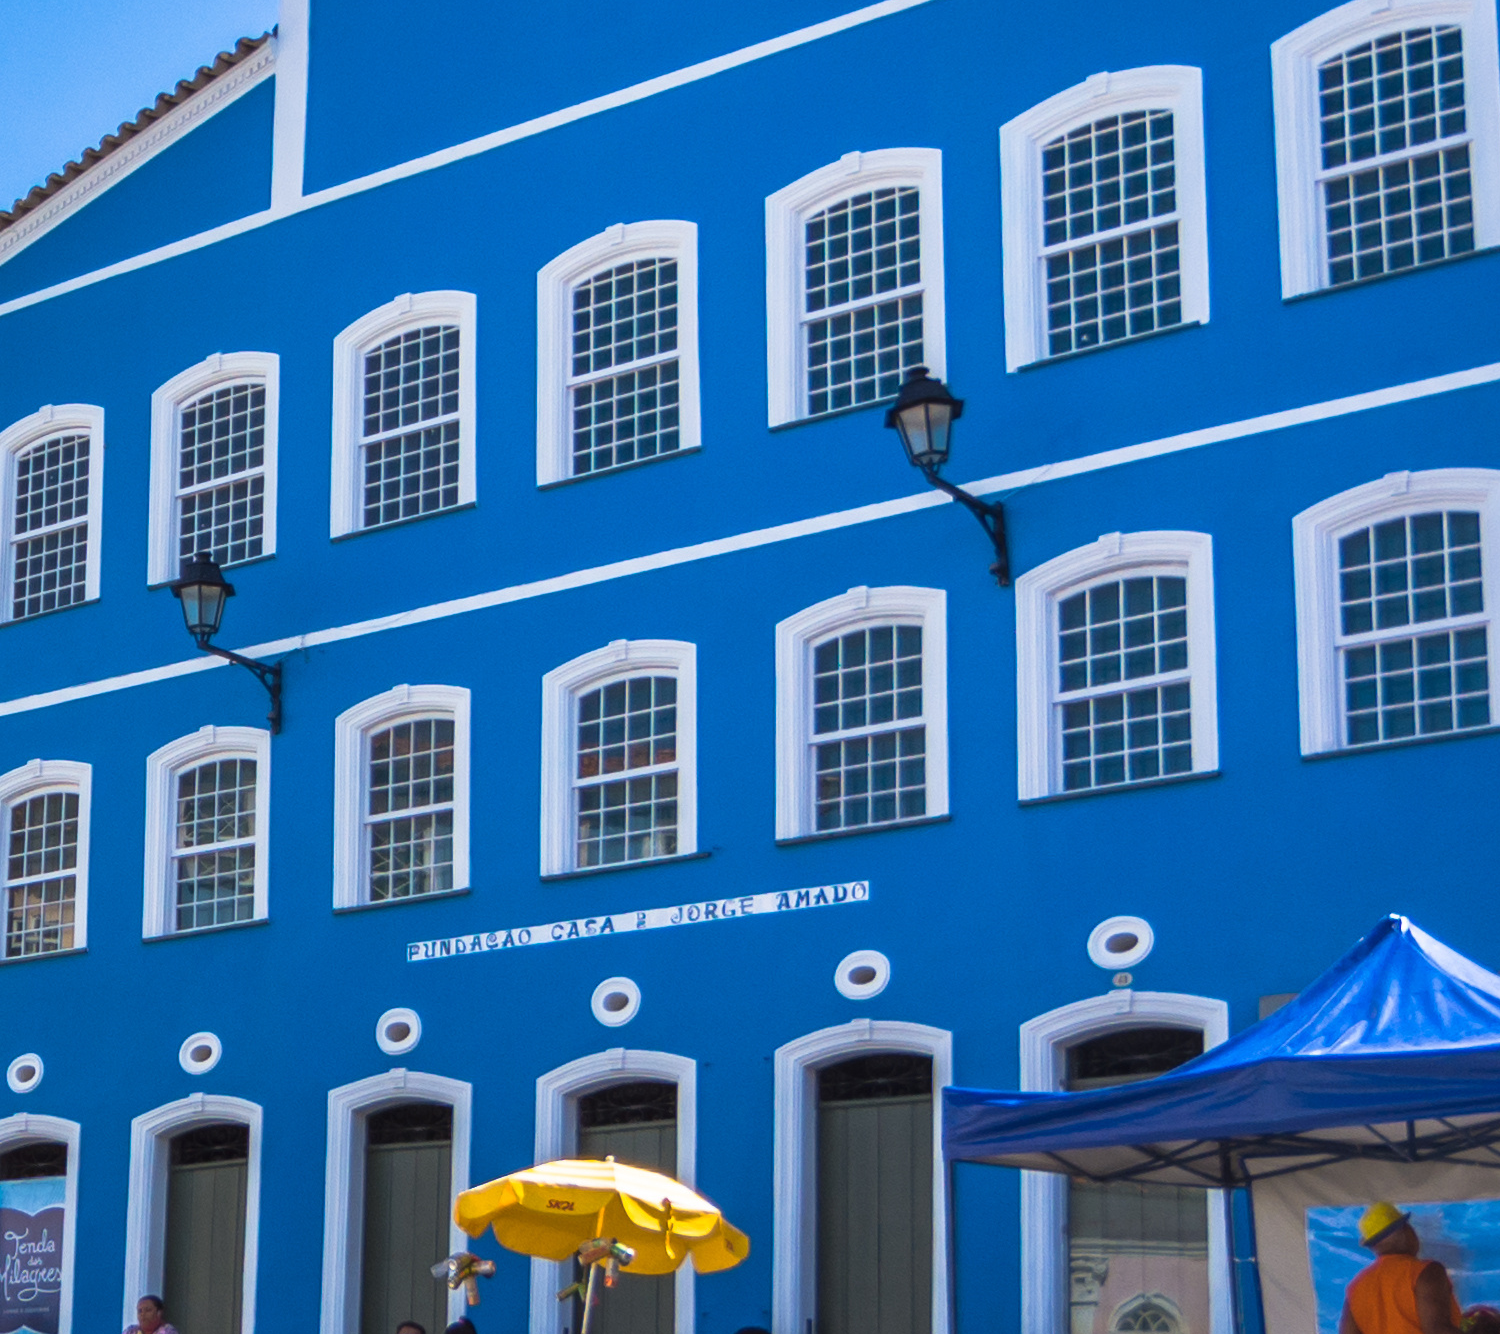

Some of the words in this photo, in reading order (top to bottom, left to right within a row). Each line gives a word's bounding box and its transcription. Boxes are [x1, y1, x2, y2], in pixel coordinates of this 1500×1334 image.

[550, 916, 615, 941] CASA
[670, 896, 754, 925] JORGE
[775, 882, 867, 912] AMADO
[546, 1197, 575, 1212] SKOL
[4, 1227, 56, 1260] Tenda
